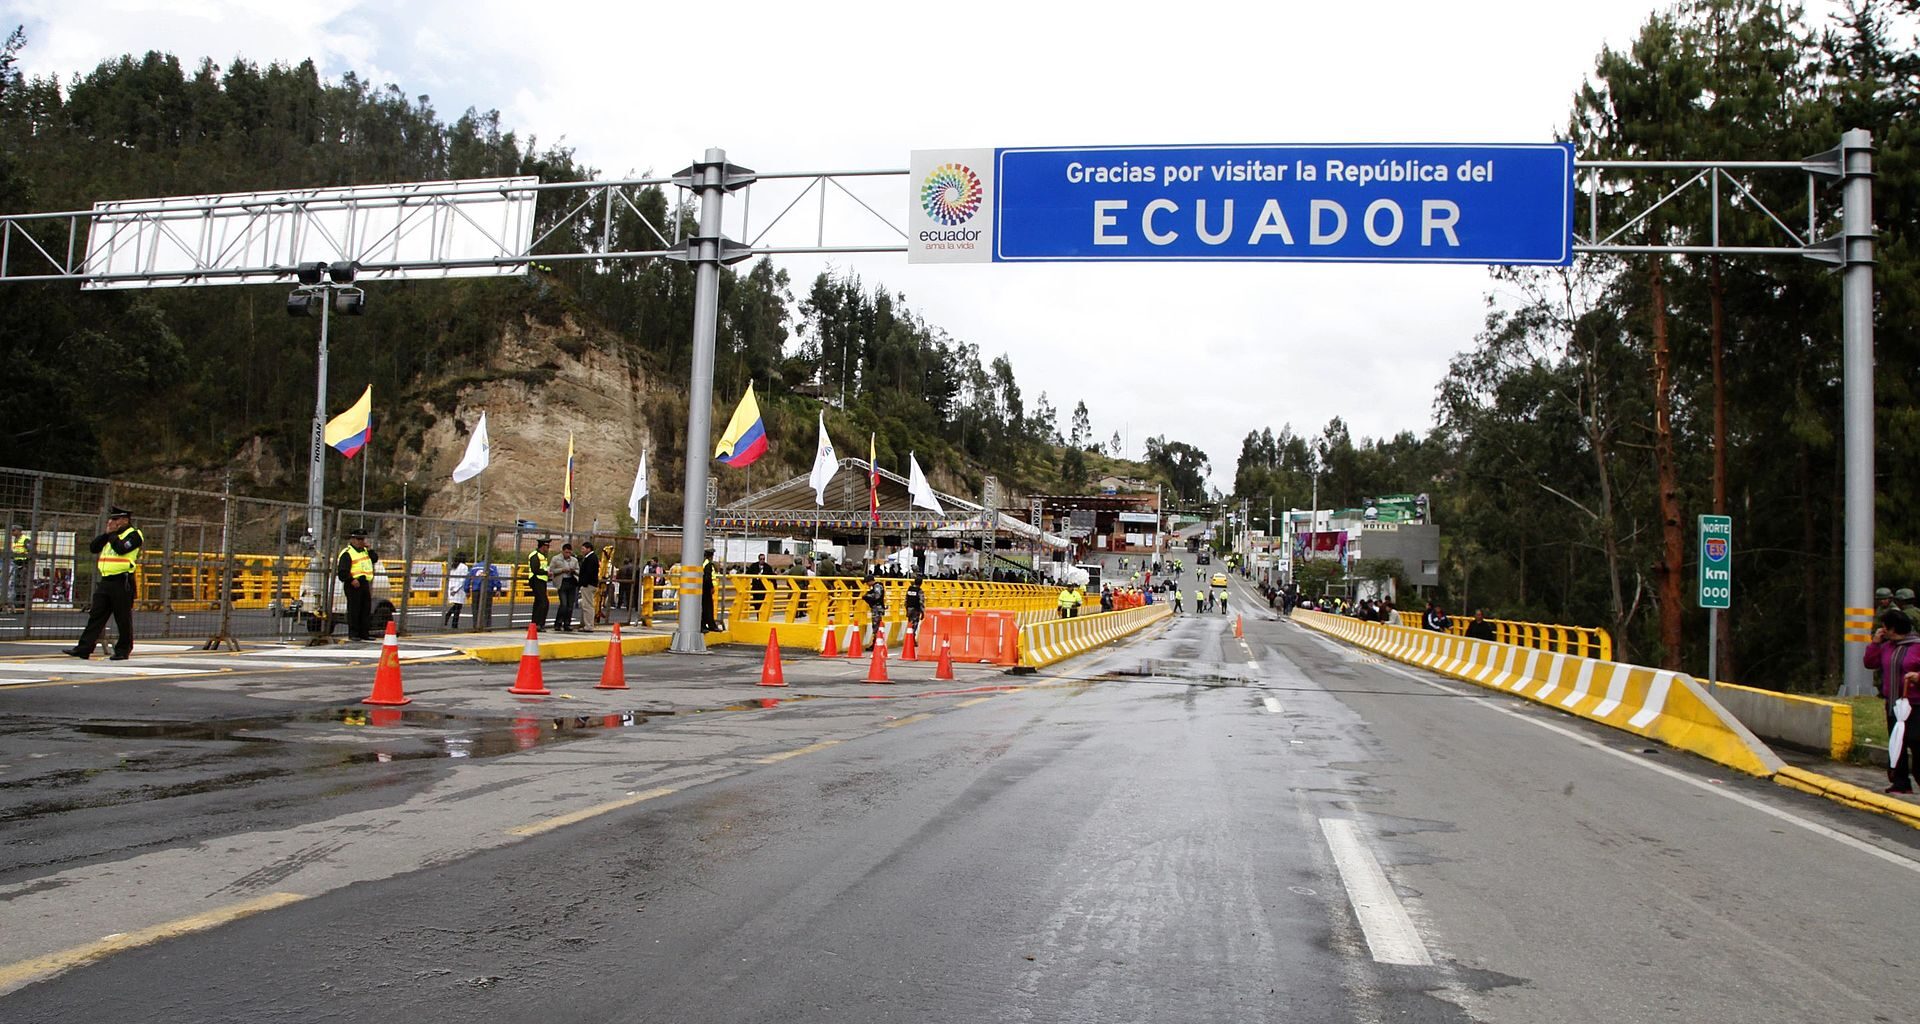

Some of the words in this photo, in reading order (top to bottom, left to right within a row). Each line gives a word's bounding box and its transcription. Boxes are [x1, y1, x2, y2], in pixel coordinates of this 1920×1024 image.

[1066, 161, 1156, 184] Gracias
[1163, 165, 1204, 187] por
[1210, 159, 1289, 182] visitar
[1296, 159, 1317, 182] la
[1326, 159, 1449, 187] República
[1456, 159, 1493, 182] del
[1093, 198, 1461, 247] ECUADOR
[919, 227, 982, 242] ecuador
[947, 242, 955, 250] la
[956, 242, 975, 250] vida
[1703, 524, 1730, 534] NORTE
[1710, 544, 1724, 556] E35
[1705, 568, 1728, 580] km
[1703, 587, 1728, 598] 000
